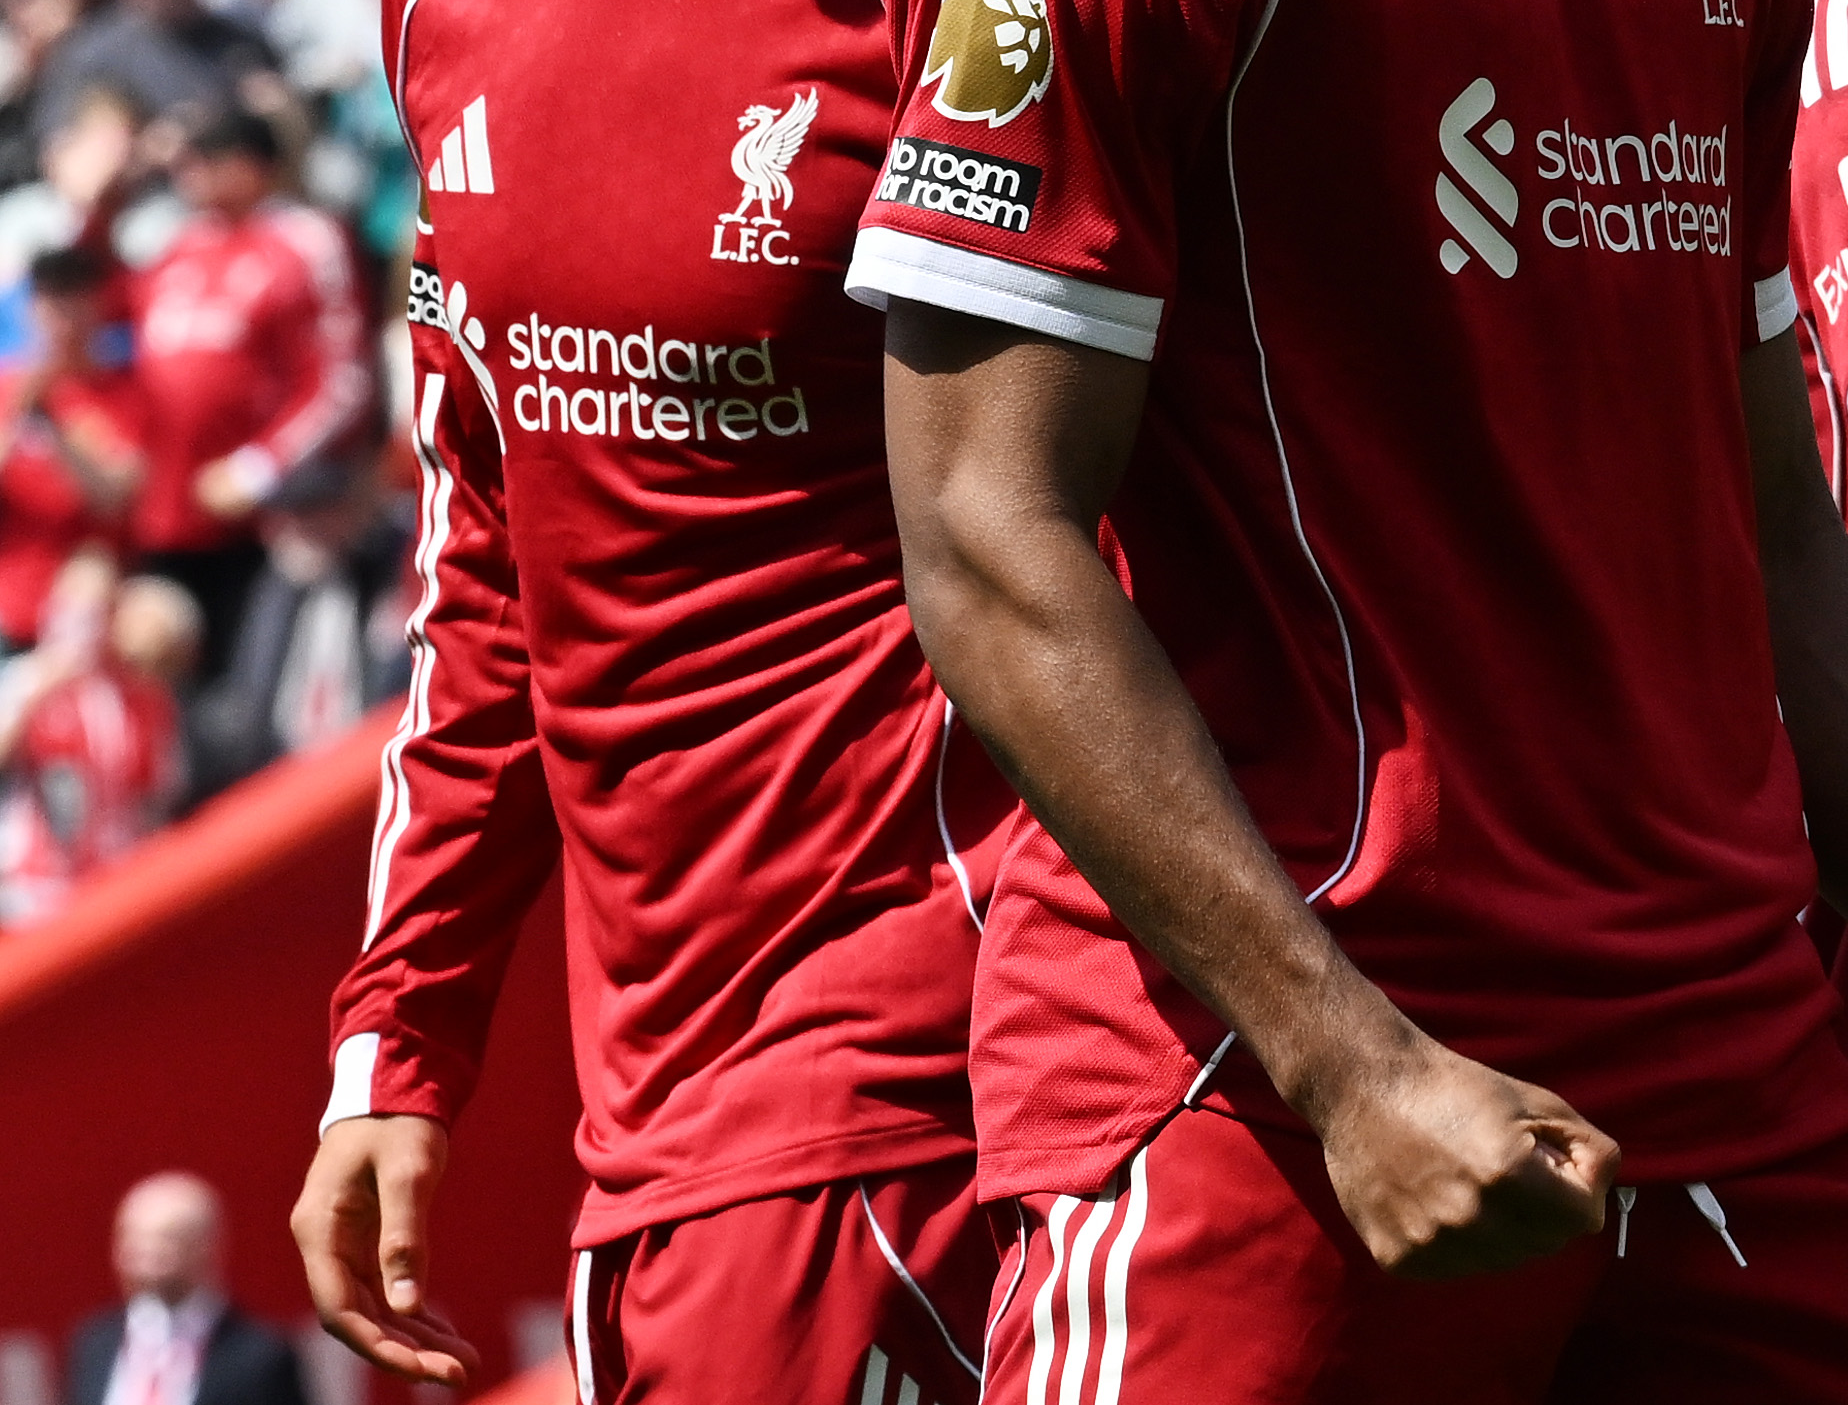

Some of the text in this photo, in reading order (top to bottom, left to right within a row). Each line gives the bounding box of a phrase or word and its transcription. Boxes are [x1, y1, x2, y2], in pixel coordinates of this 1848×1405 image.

[919, 149, 1020, 198] room
[1536, 117, 1727, 186] standard
[908, 178, 1030, 232] racism
[1542, 185, 1731, 256] chartered
[710, 224, 800, 265] L.F.C.
[507, 311, 775, 386] standard
[513, 374, 809, 441] chartered
